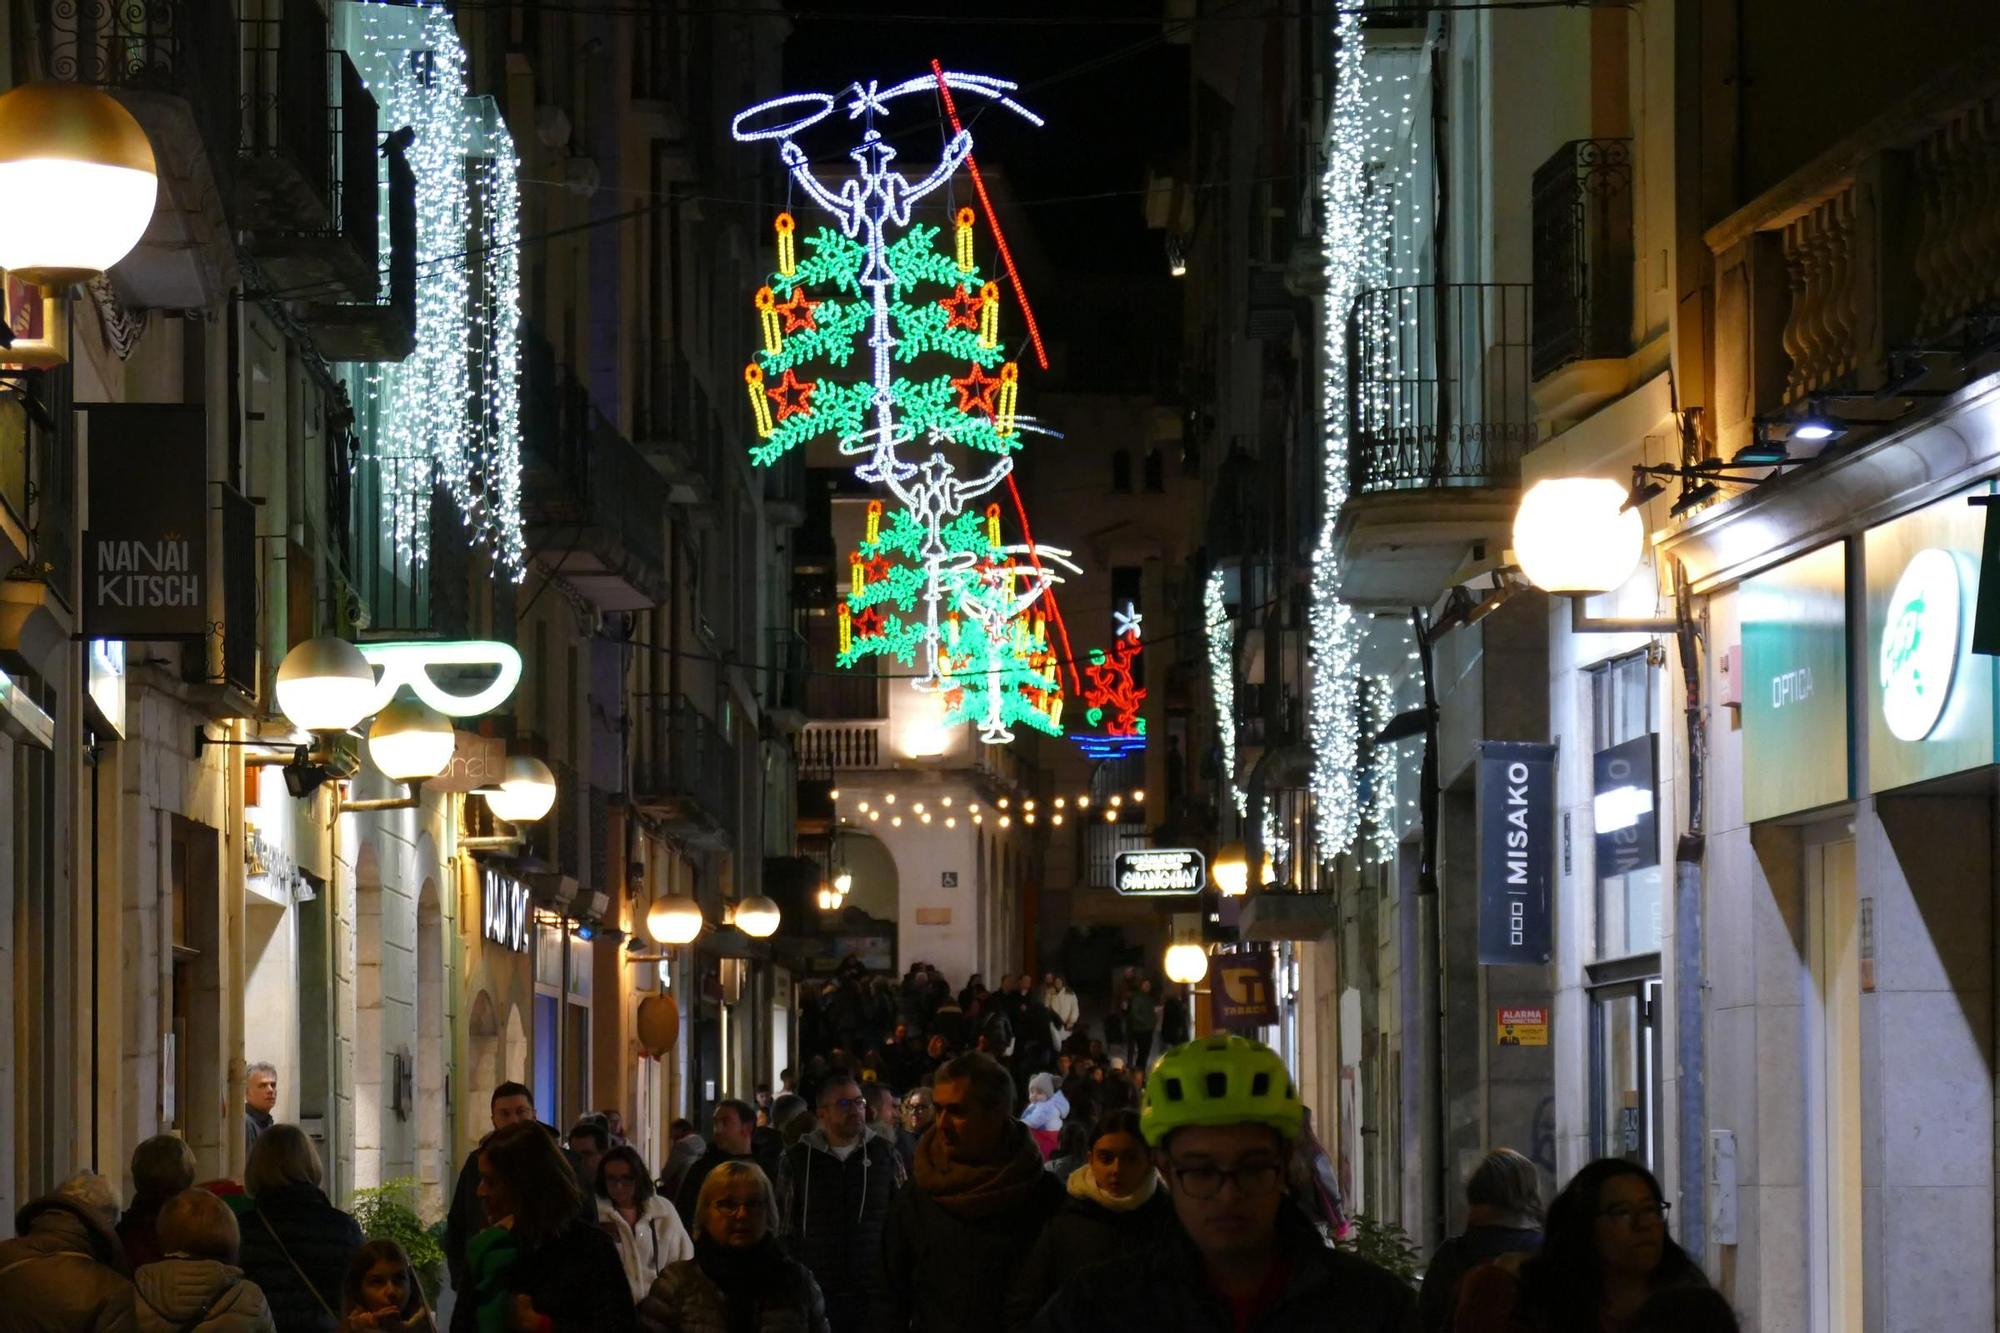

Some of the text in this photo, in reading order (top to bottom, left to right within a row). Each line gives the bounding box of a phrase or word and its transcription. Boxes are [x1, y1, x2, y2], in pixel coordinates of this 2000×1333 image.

[98, 541, 189, 571] NANAI
[98, 575, 199, 607] KITSCH
[1773, 667, 1814, 708] OPTICA
[1507, 762, 1529, 884] MISAKO
[1503, 1010, 1541, 1019] ALARMA
